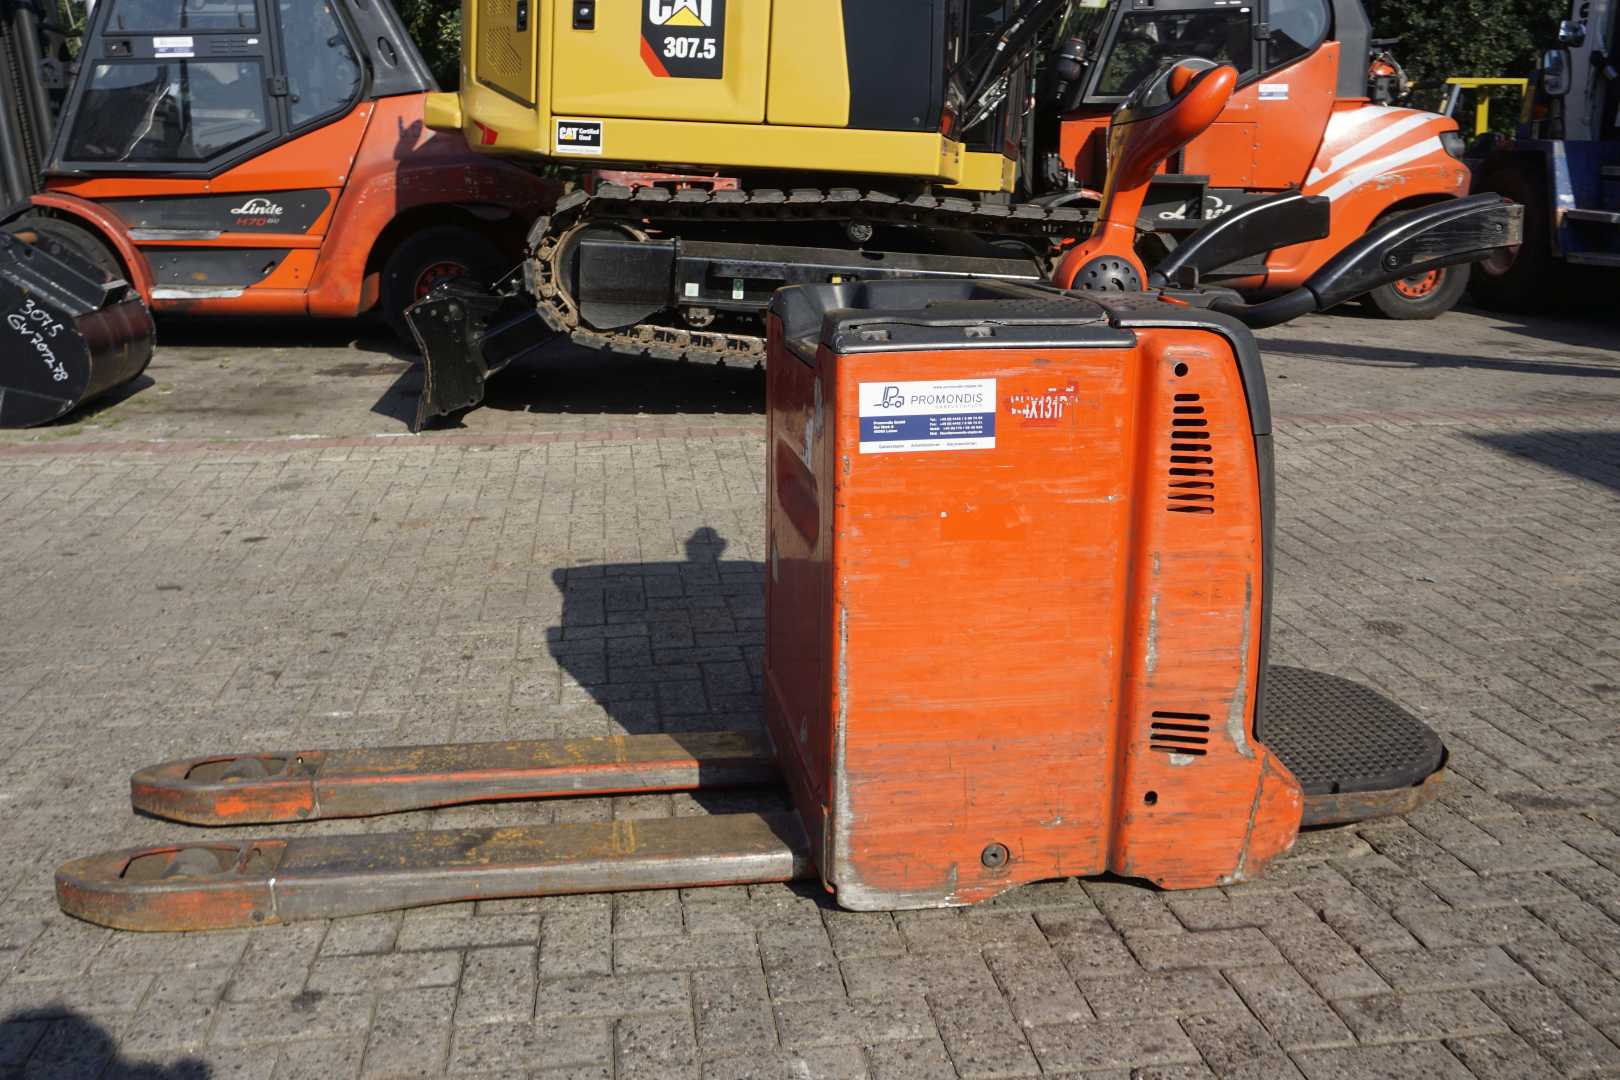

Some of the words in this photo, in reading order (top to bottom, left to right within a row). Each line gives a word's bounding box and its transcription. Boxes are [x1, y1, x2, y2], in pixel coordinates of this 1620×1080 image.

[663, 36, 716, 59] 307.5
[559, 126, 578, 140] CAT
[230, 198, 284, 215] Linde
[910, 392, 984, 406] PROMONDIS
